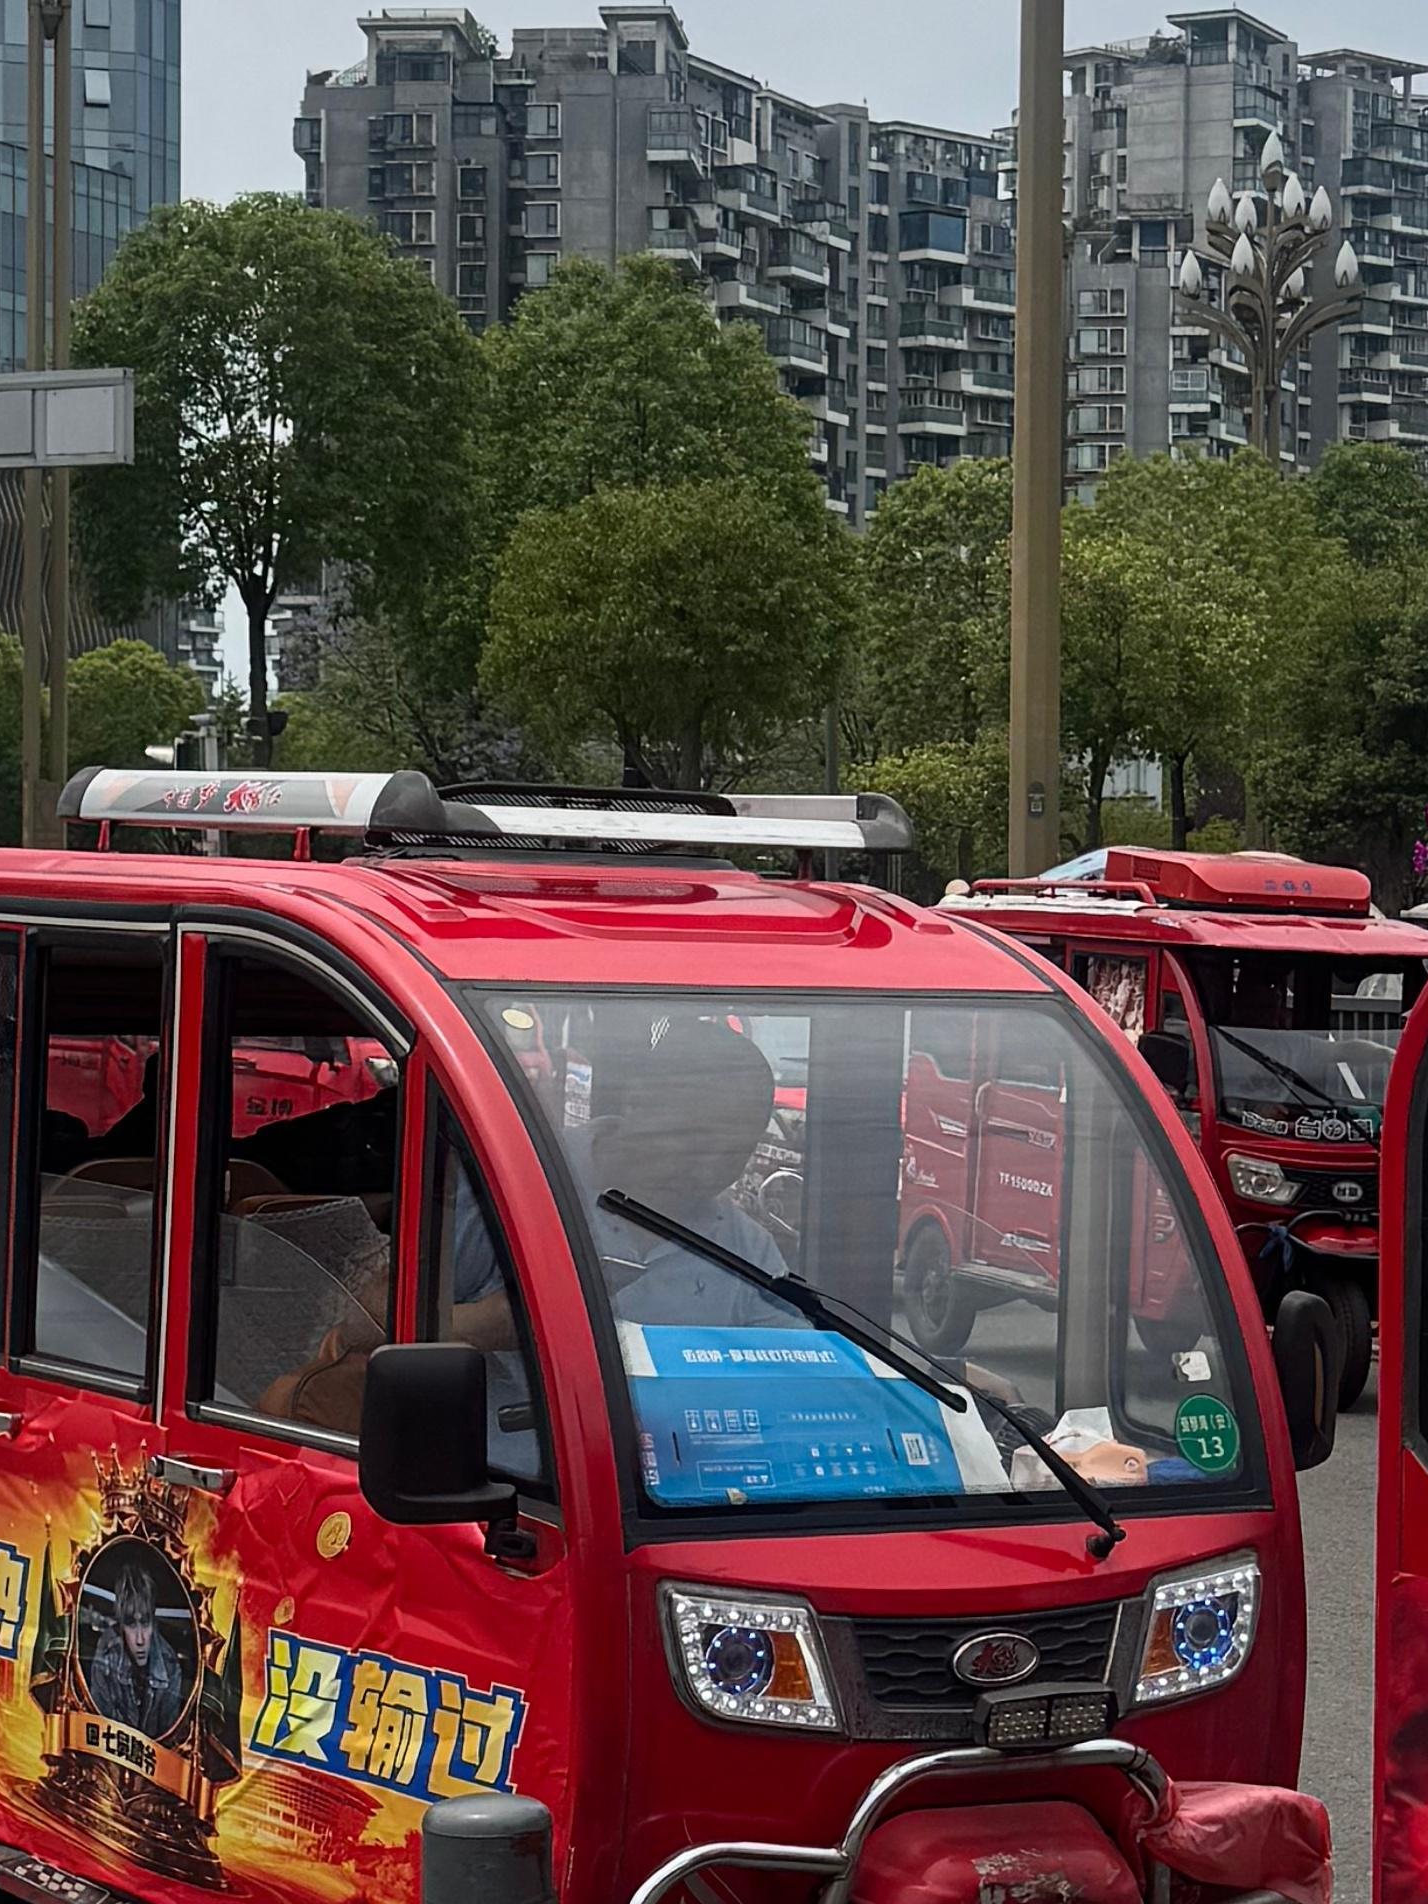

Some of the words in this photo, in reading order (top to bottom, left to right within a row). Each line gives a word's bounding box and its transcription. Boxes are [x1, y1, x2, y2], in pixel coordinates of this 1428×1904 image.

[1197, 1435, 1225, 1459] 13
[260, 1636, 519, 1797] 没输过
